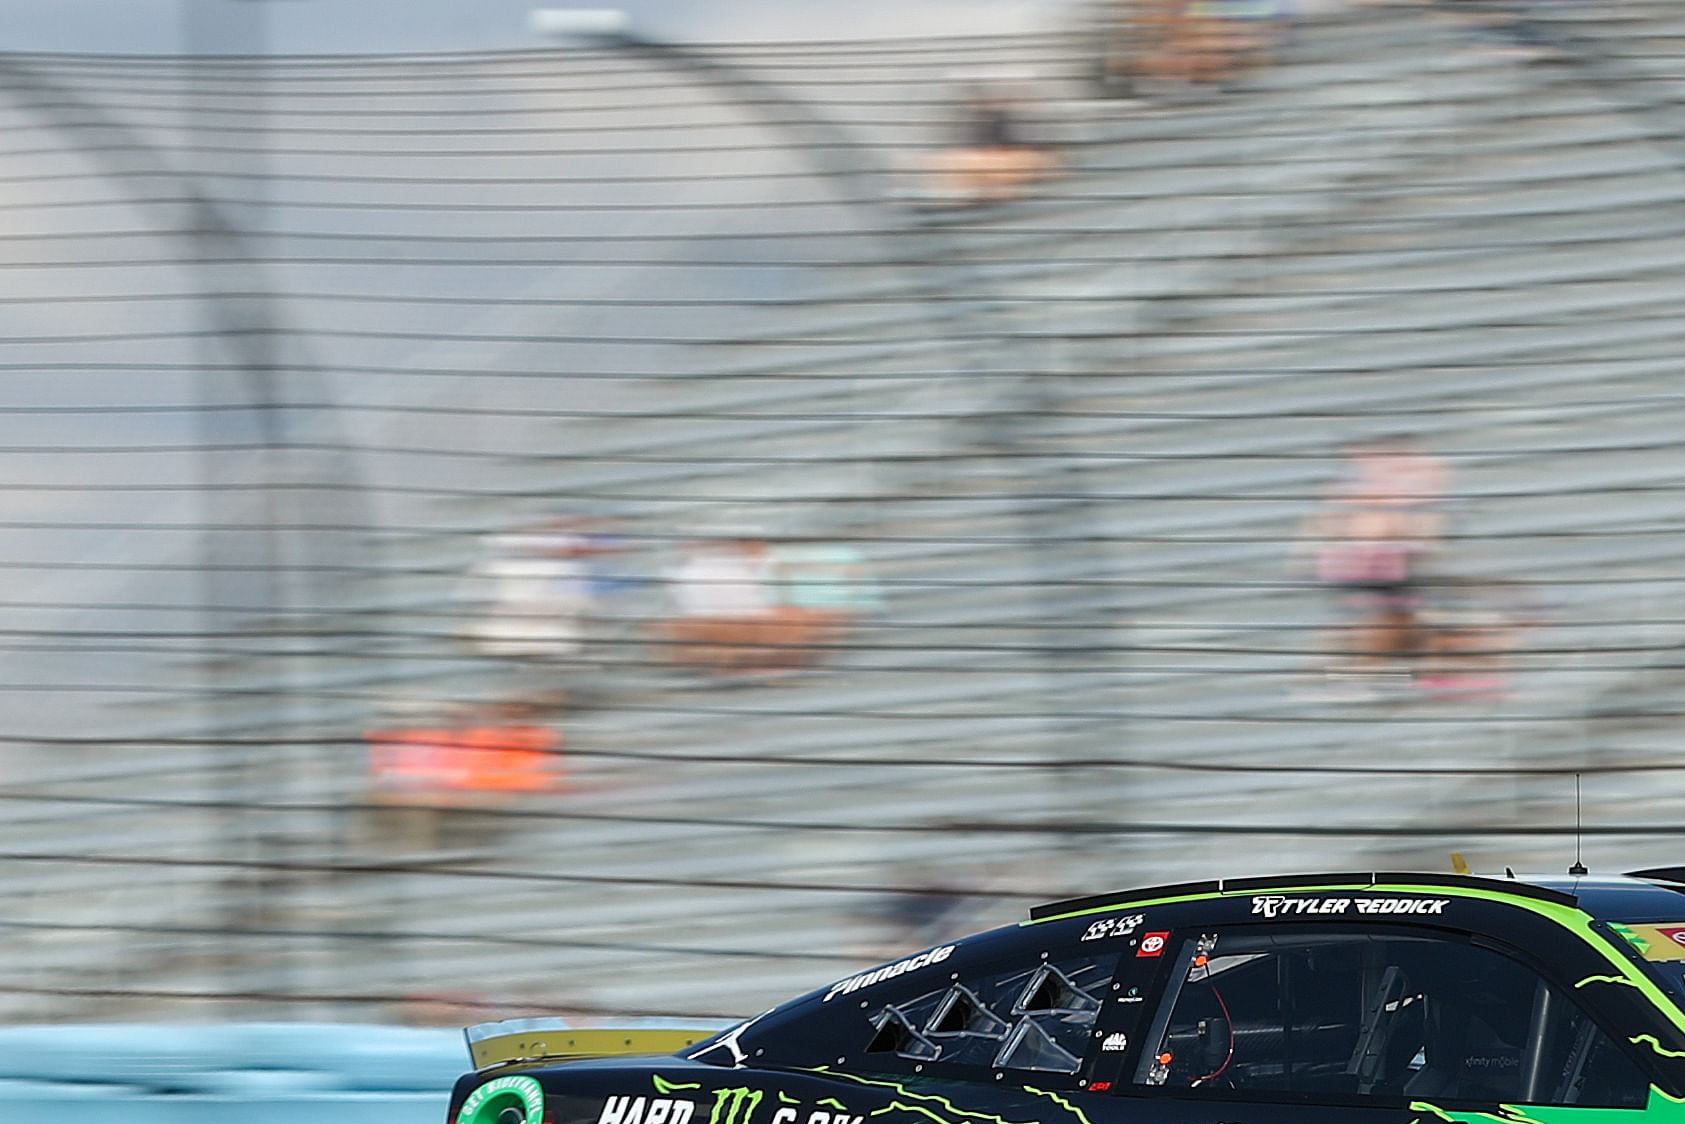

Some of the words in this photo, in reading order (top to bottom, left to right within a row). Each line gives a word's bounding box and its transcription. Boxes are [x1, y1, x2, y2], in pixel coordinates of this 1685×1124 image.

[1281, 898, 1351, 914] TYLER
[1354, 898, 1450, 914] REDDICK
[822, 945, 956, 1003] Pinnacle
